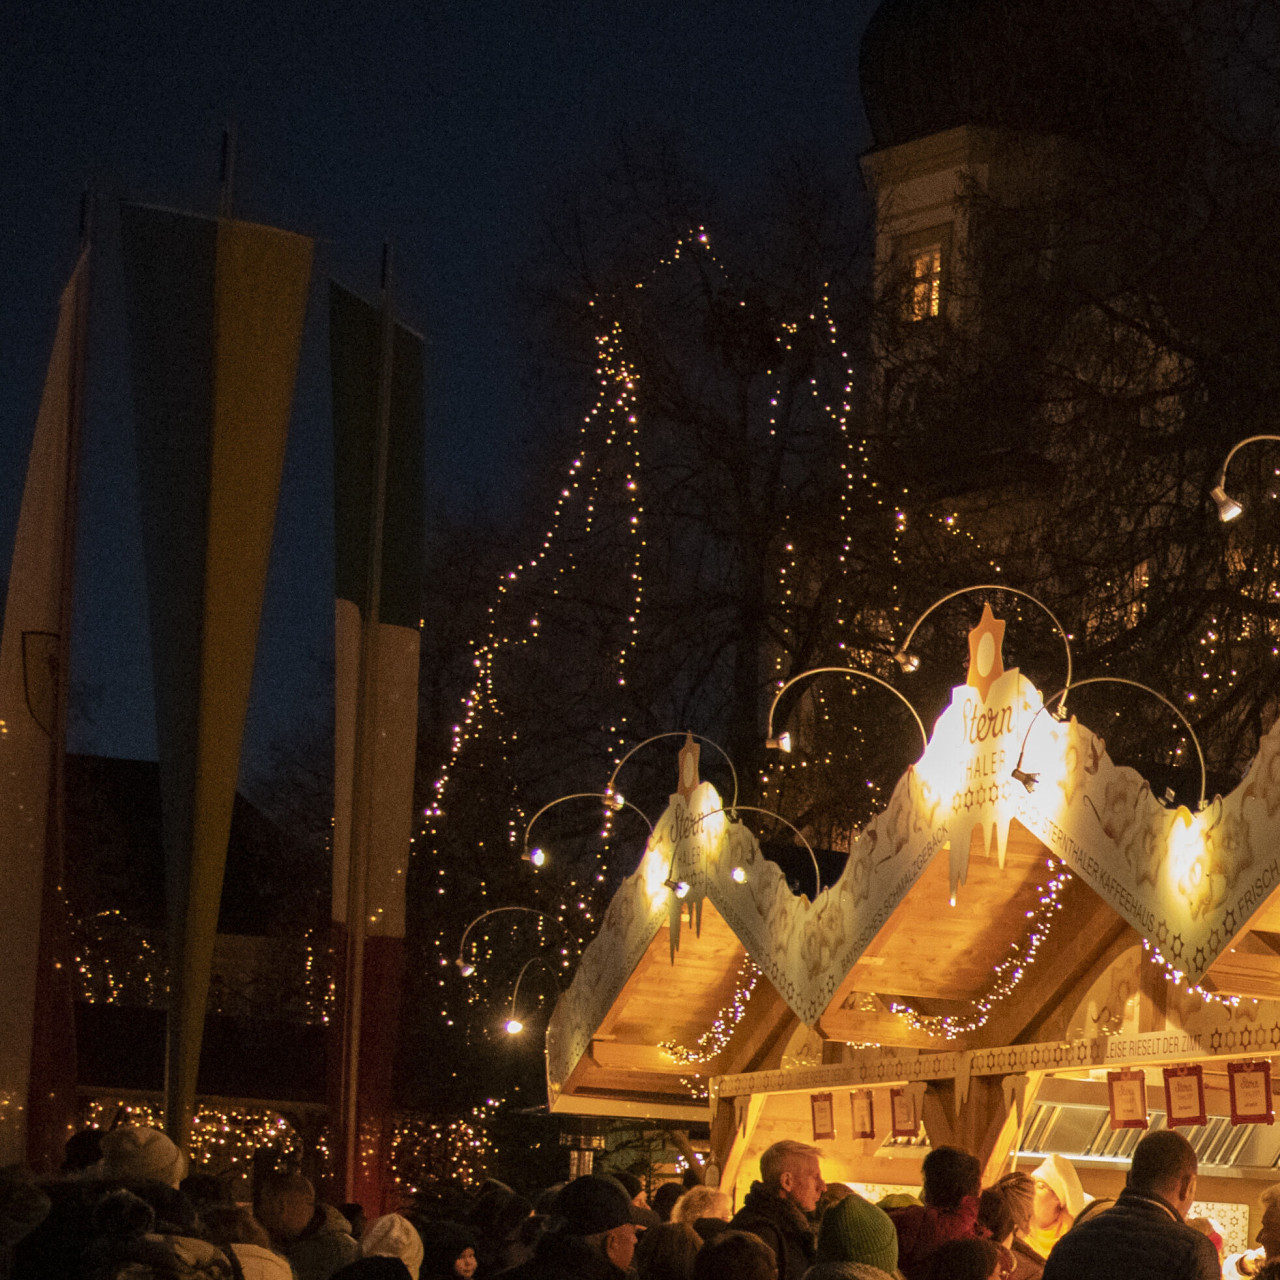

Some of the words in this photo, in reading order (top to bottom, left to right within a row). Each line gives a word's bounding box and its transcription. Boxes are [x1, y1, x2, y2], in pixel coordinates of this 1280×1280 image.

[962, 698, 1015, 744] Stern
[670, 803, 704, 843] Stern
[1042, 816, 1099, 880] STERNTHALER
[1100, 870, 1156, 933] KAFFEEHAUS
[1237, 859, 1280, 917] FRISCH
[1129, 1038, 1161, 1056] RIESELT
[1163, 1036, 1180, 1054] DER
